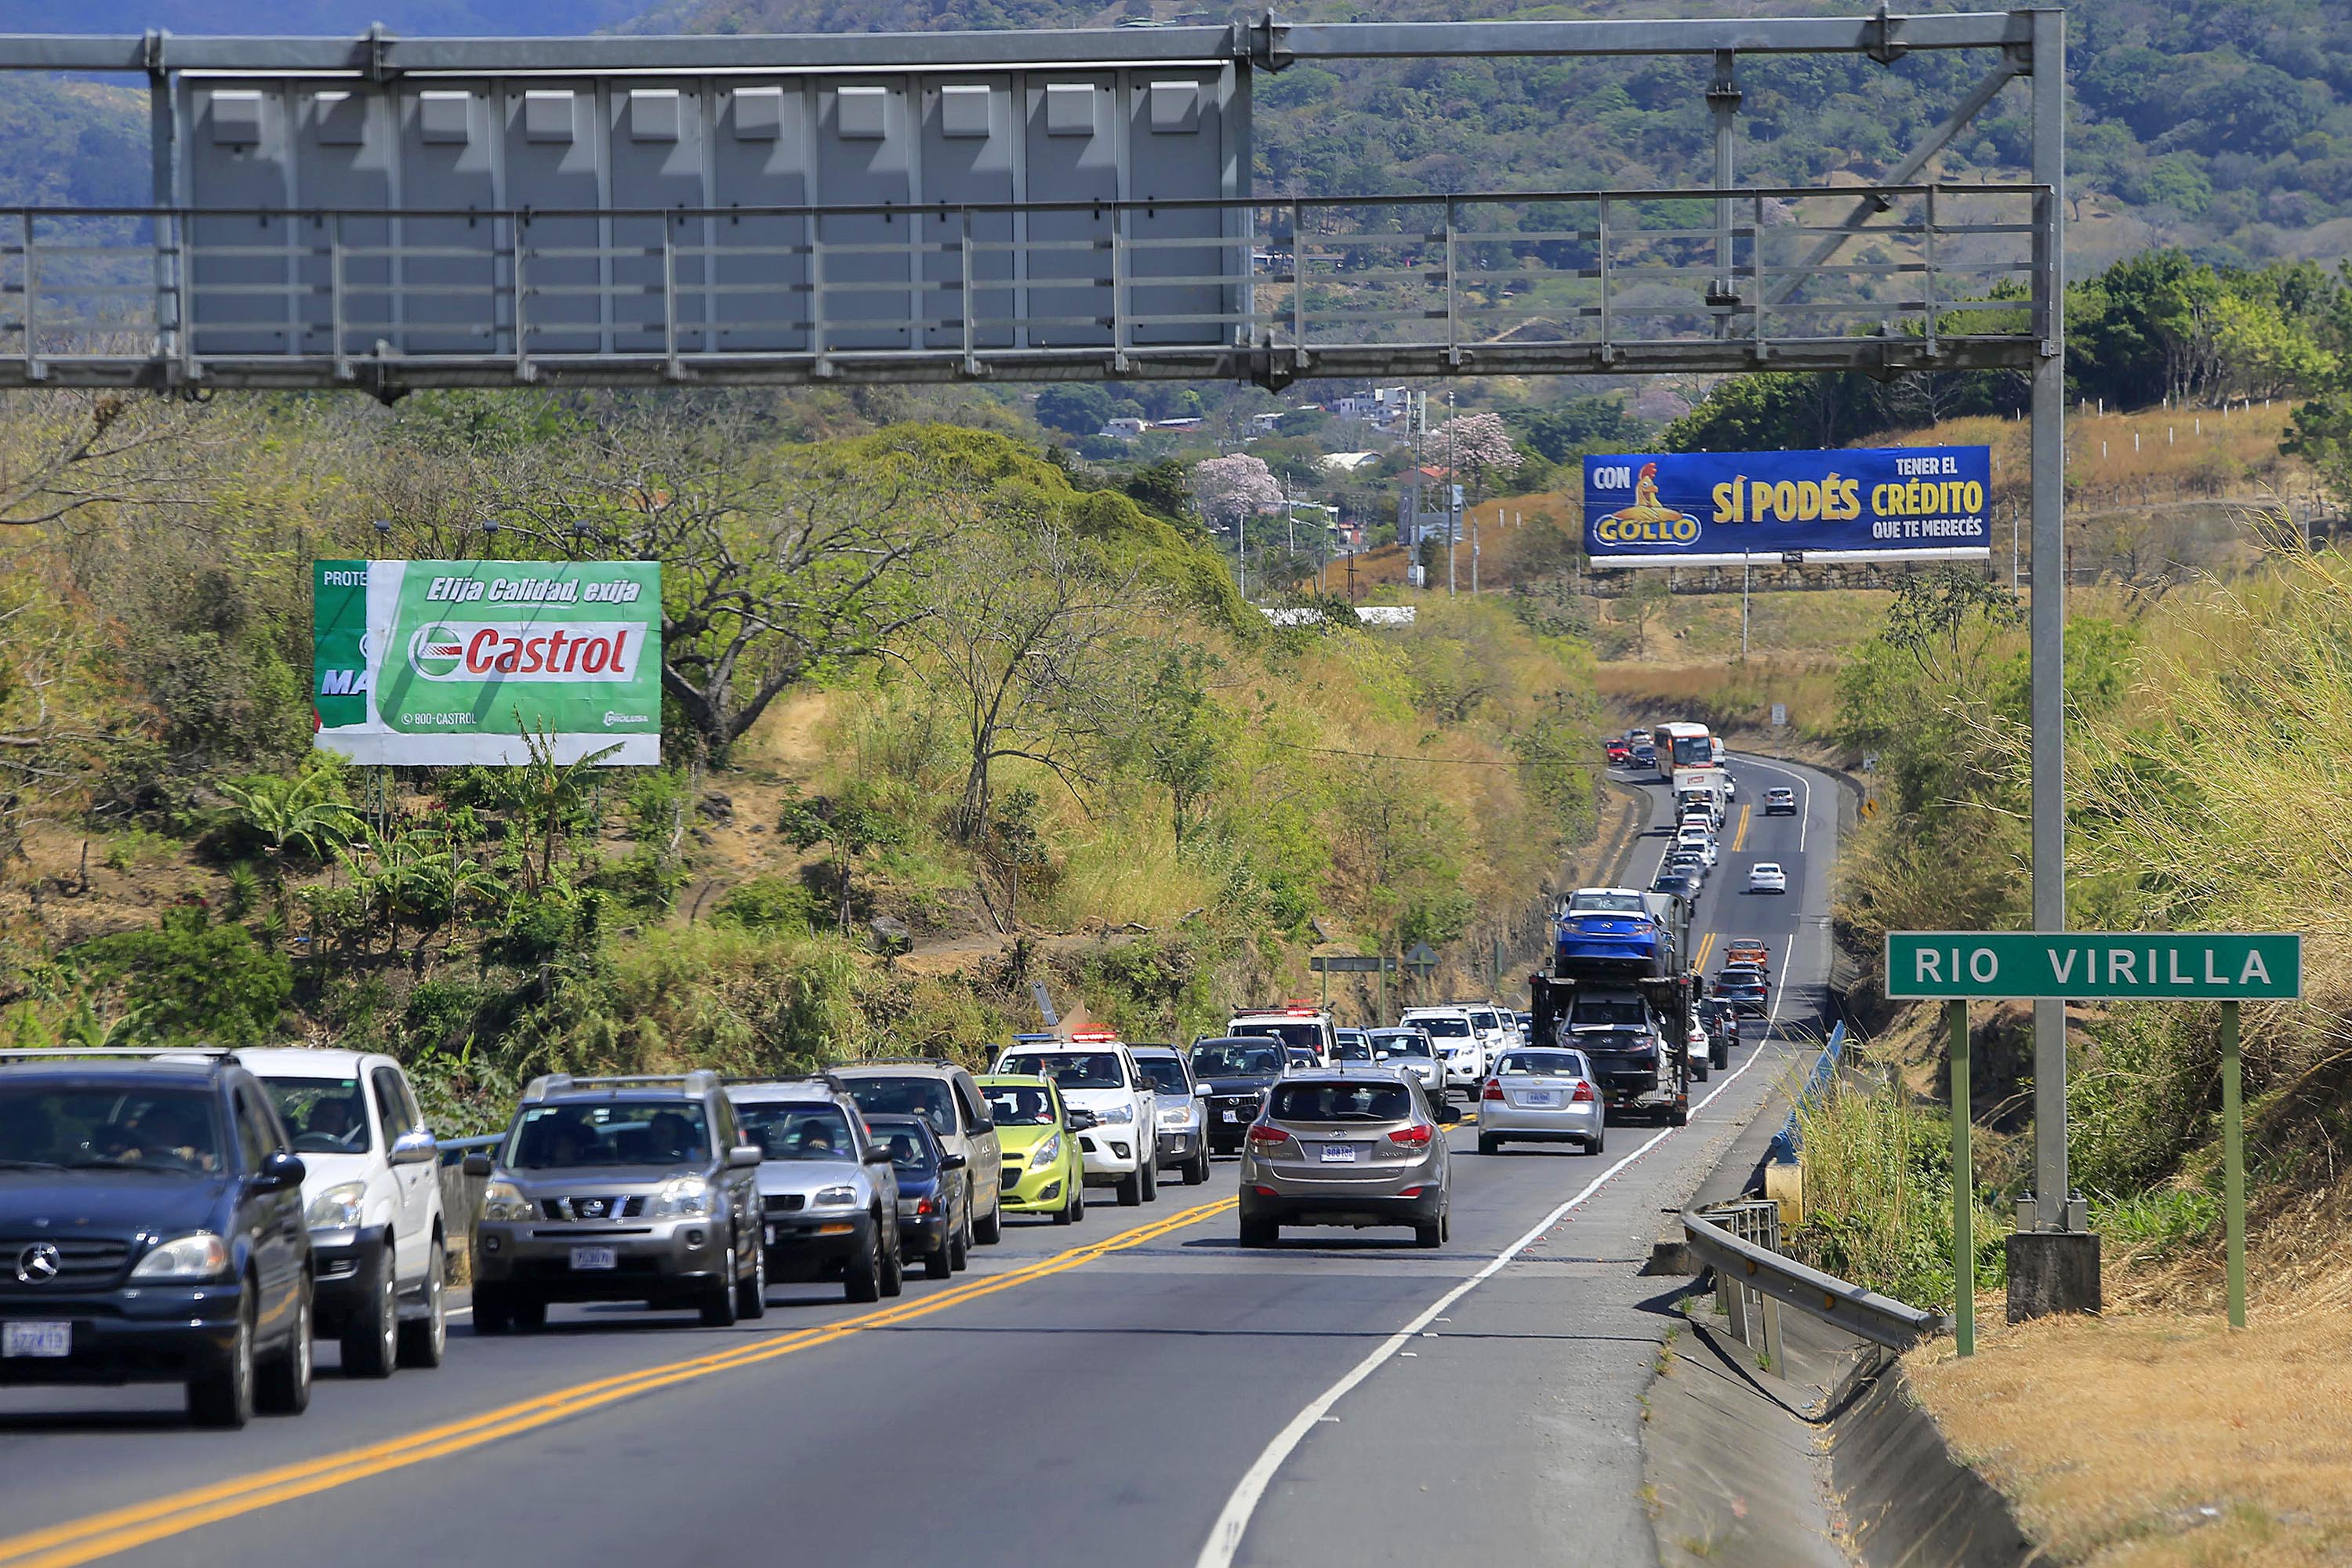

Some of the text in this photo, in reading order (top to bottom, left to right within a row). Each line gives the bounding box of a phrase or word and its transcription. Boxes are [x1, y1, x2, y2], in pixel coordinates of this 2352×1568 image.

[1593, 466, 1631, 490] CON
[1896, 456, 1958, 476] TENER EL
[1712, 472, 1861, 524] SÍ PODÉS
[1871, 477, 1984, 517] CRÉDITO
[1598, 519, 1697, 541] GOLLO
[1872, 516, 1983, 539] QUE TE MERECÉS
[324, 571, 367, 586] PROTE
[426, 577, 641, 604] Elija Calidad, exija
[466, 628, 627, 675] Castrol
[415, 713, 477, 725] 800-CASTROL
[1915, 947, 2272, 985] RIO VIRILLA
